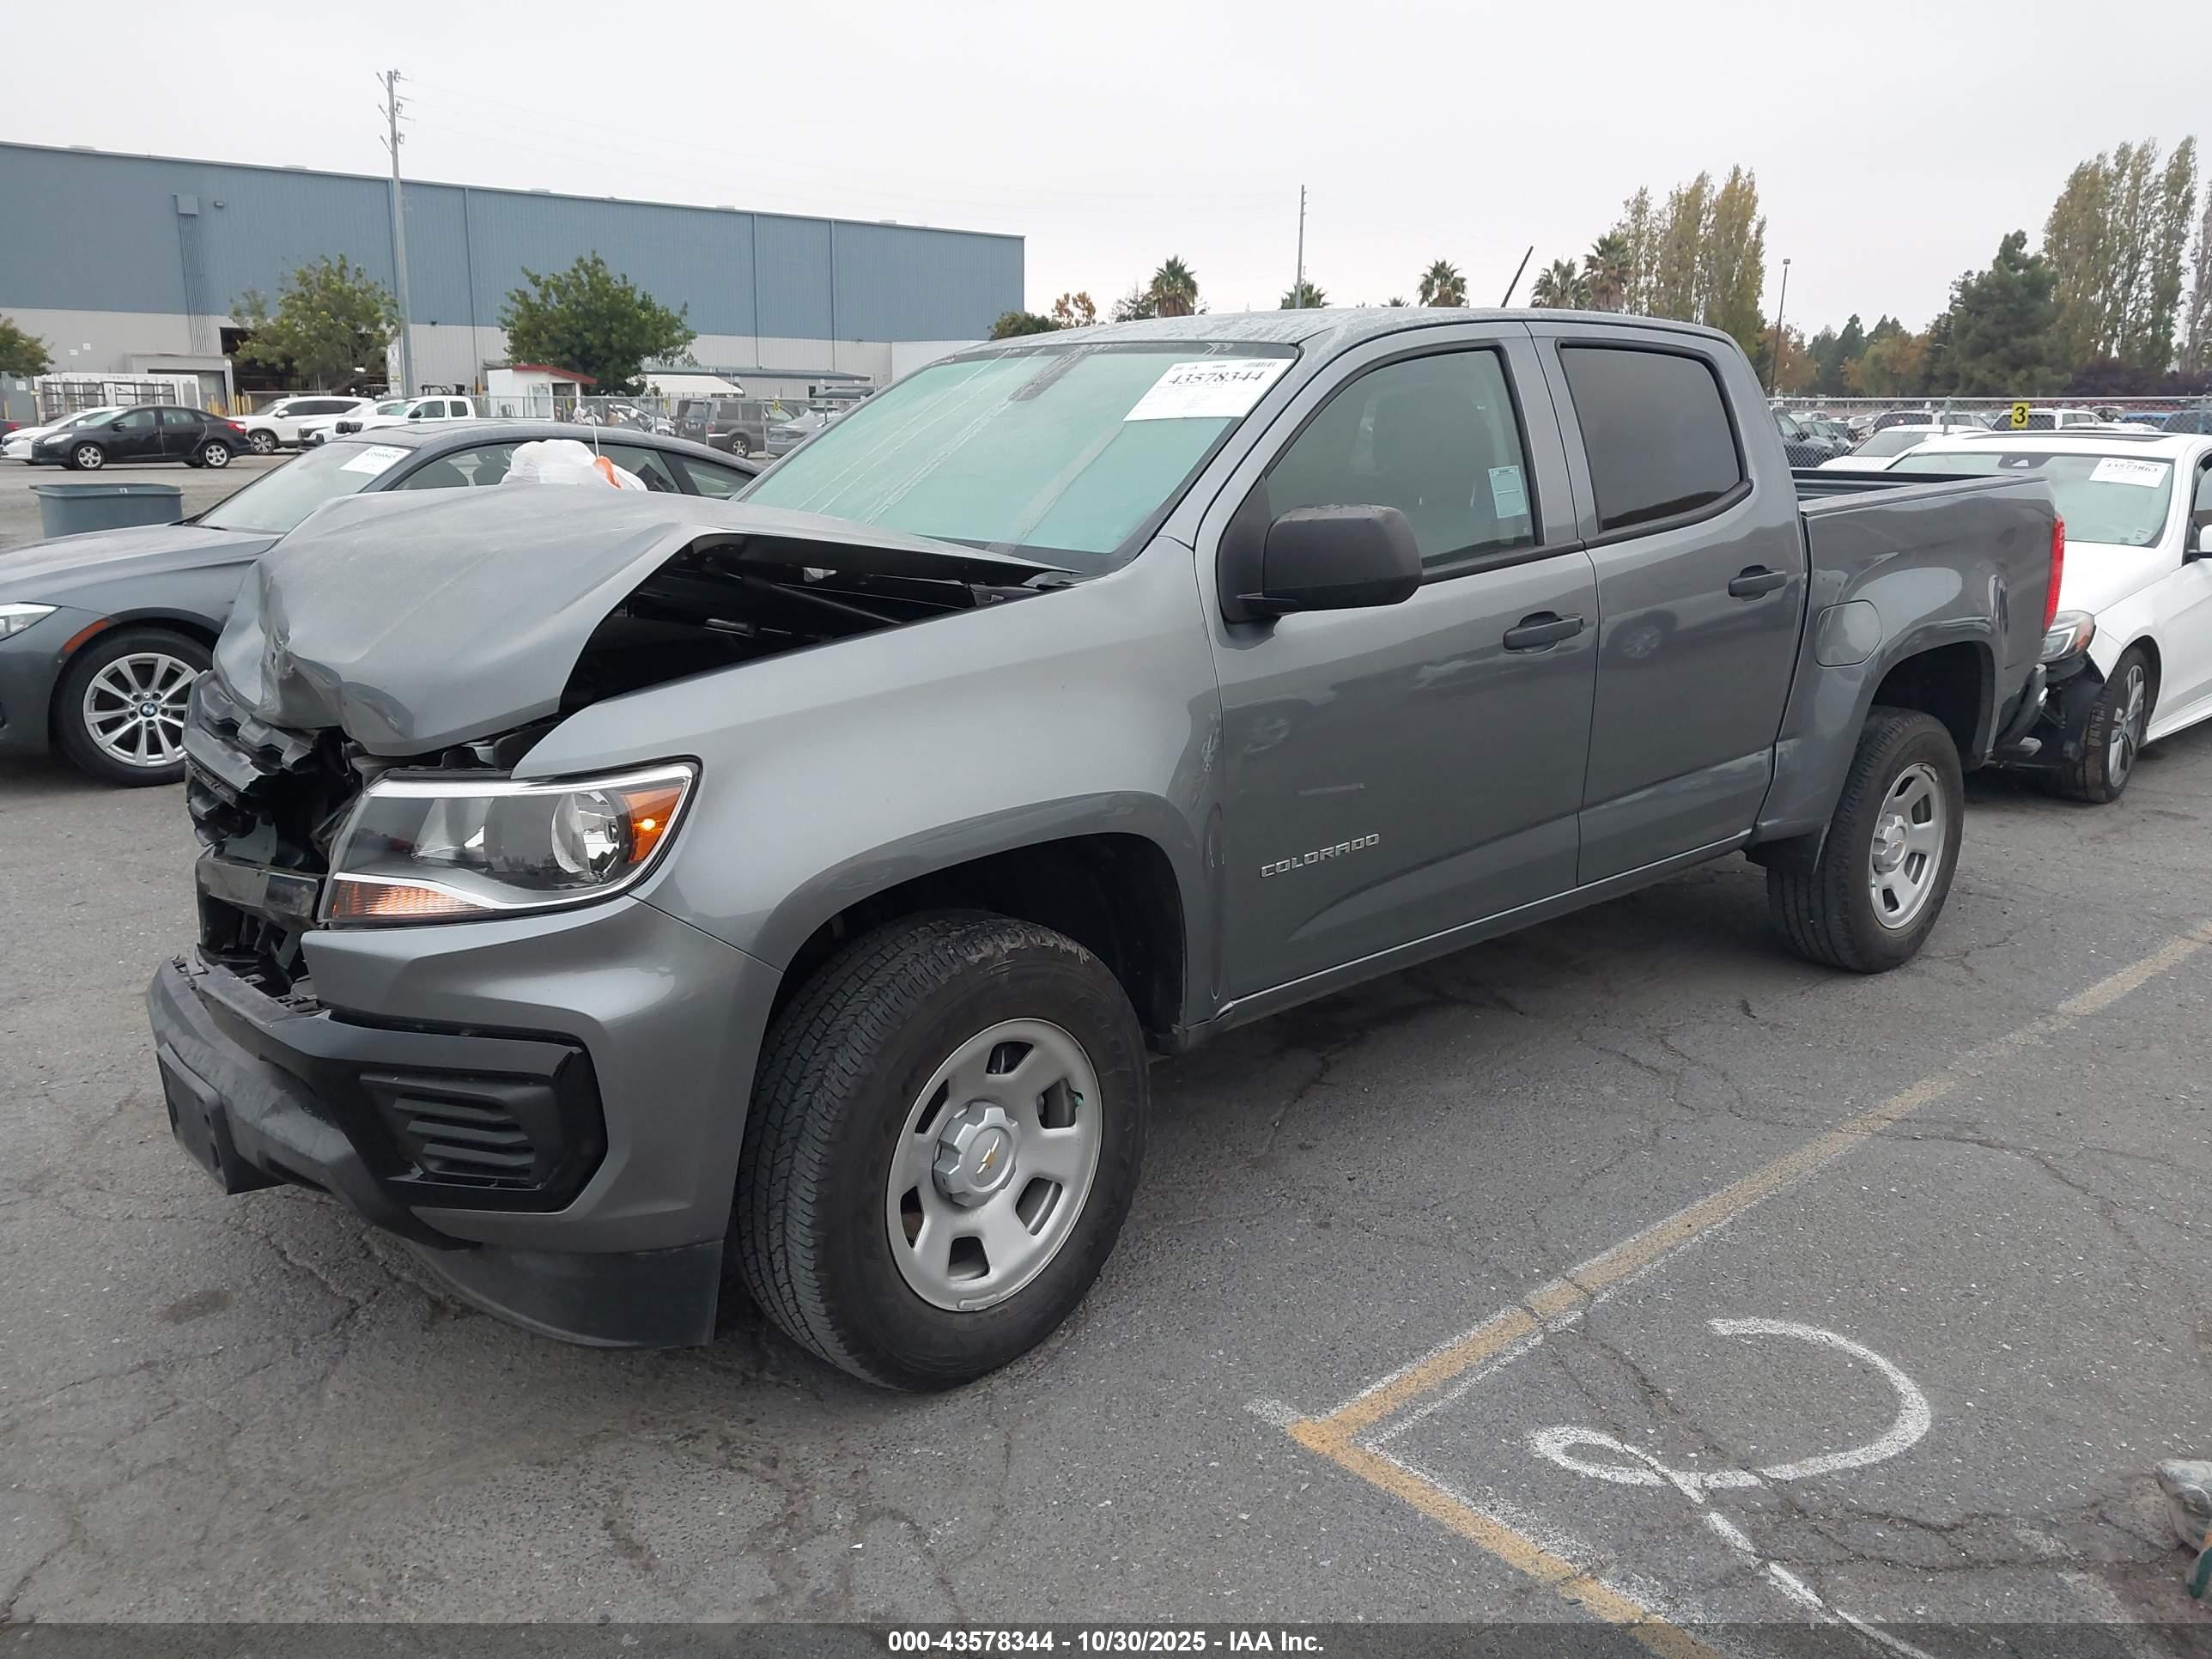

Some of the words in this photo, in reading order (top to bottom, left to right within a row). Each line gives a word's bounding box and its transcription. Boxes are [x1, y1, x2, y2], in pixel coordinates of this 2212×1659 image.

[1169, 370, 1266, 385] 43578344
[2014, 405, 2026, 424] 3
[1261, 833, 1380, 878] COLORADO
